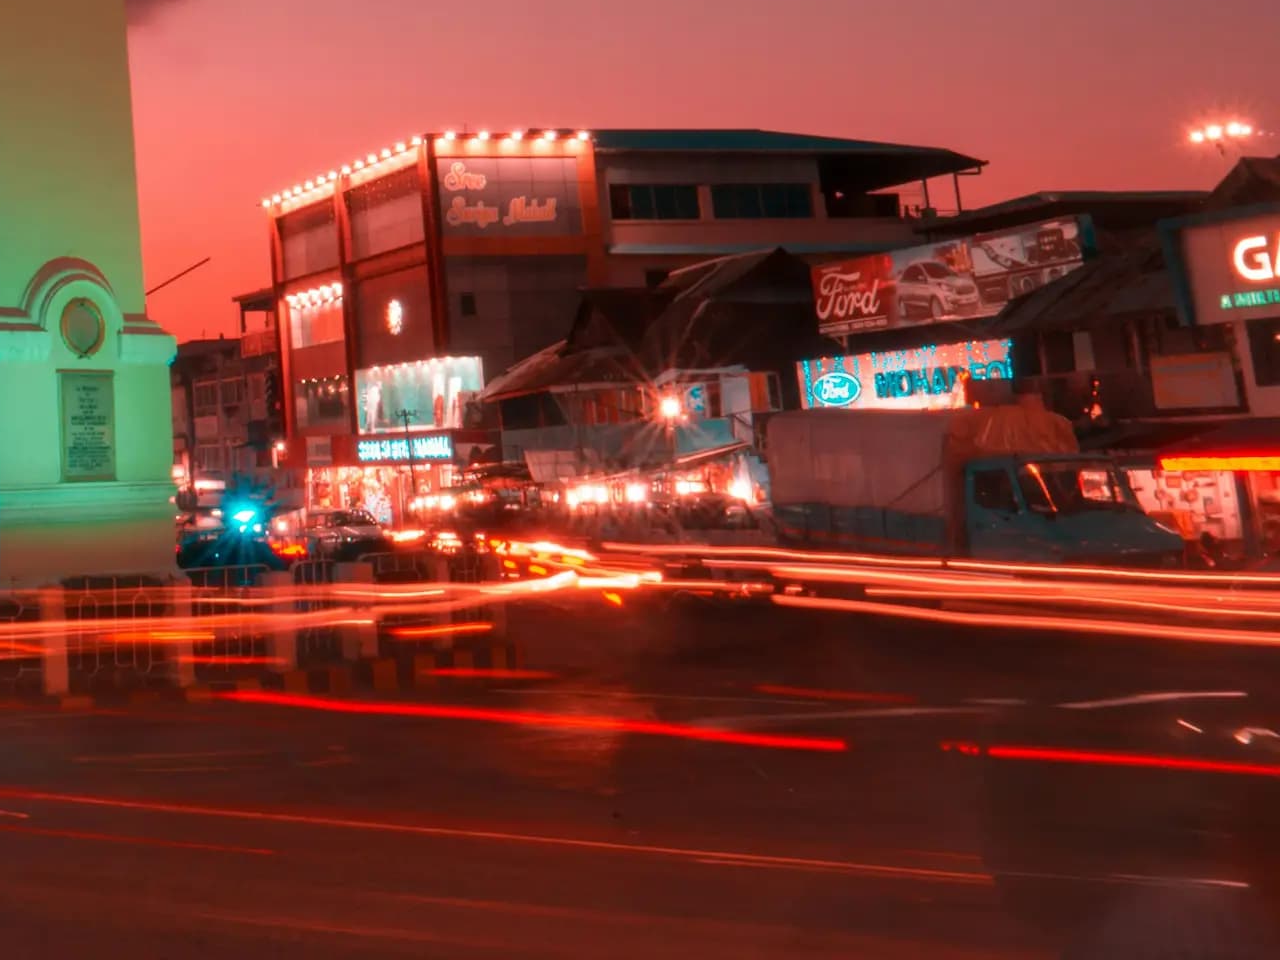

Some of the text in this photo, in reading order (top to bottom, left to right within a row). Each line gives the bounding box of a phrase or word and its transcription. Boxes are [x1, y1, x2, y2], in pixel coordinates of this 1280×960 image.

[1233, 230, 1280, 281] G
[816, 271, 880, 320] Ford
[821, 377, 850, 399] Ford
